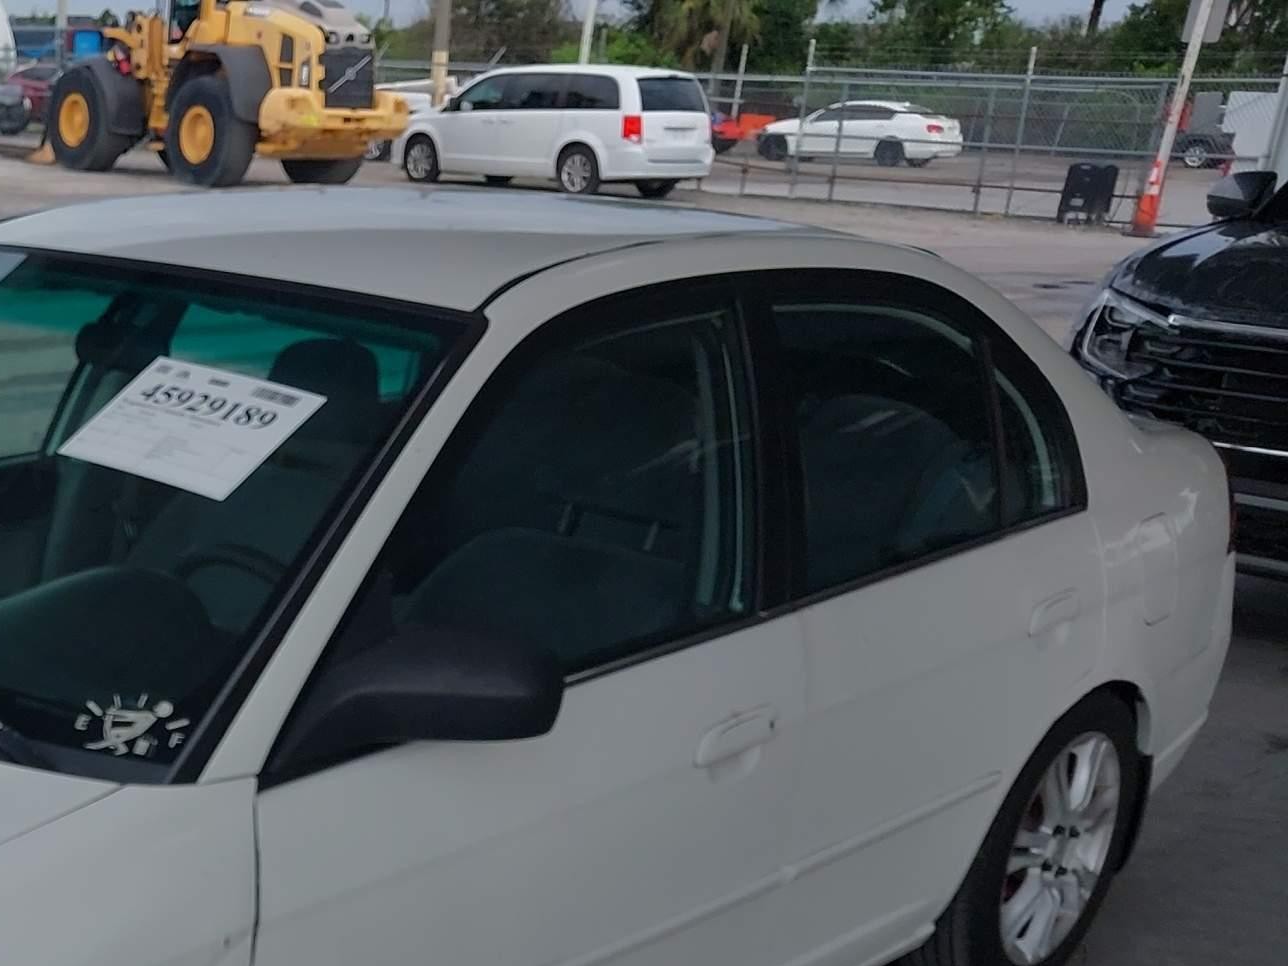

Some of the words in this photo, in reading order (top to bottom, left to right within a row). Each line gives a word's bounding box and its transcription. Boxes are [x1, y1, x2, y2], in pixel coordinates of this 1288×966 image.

[140, 383, 278, 430] 45929189
[74, 713, 92, 731] E
[168, 731, 186, 749] F
